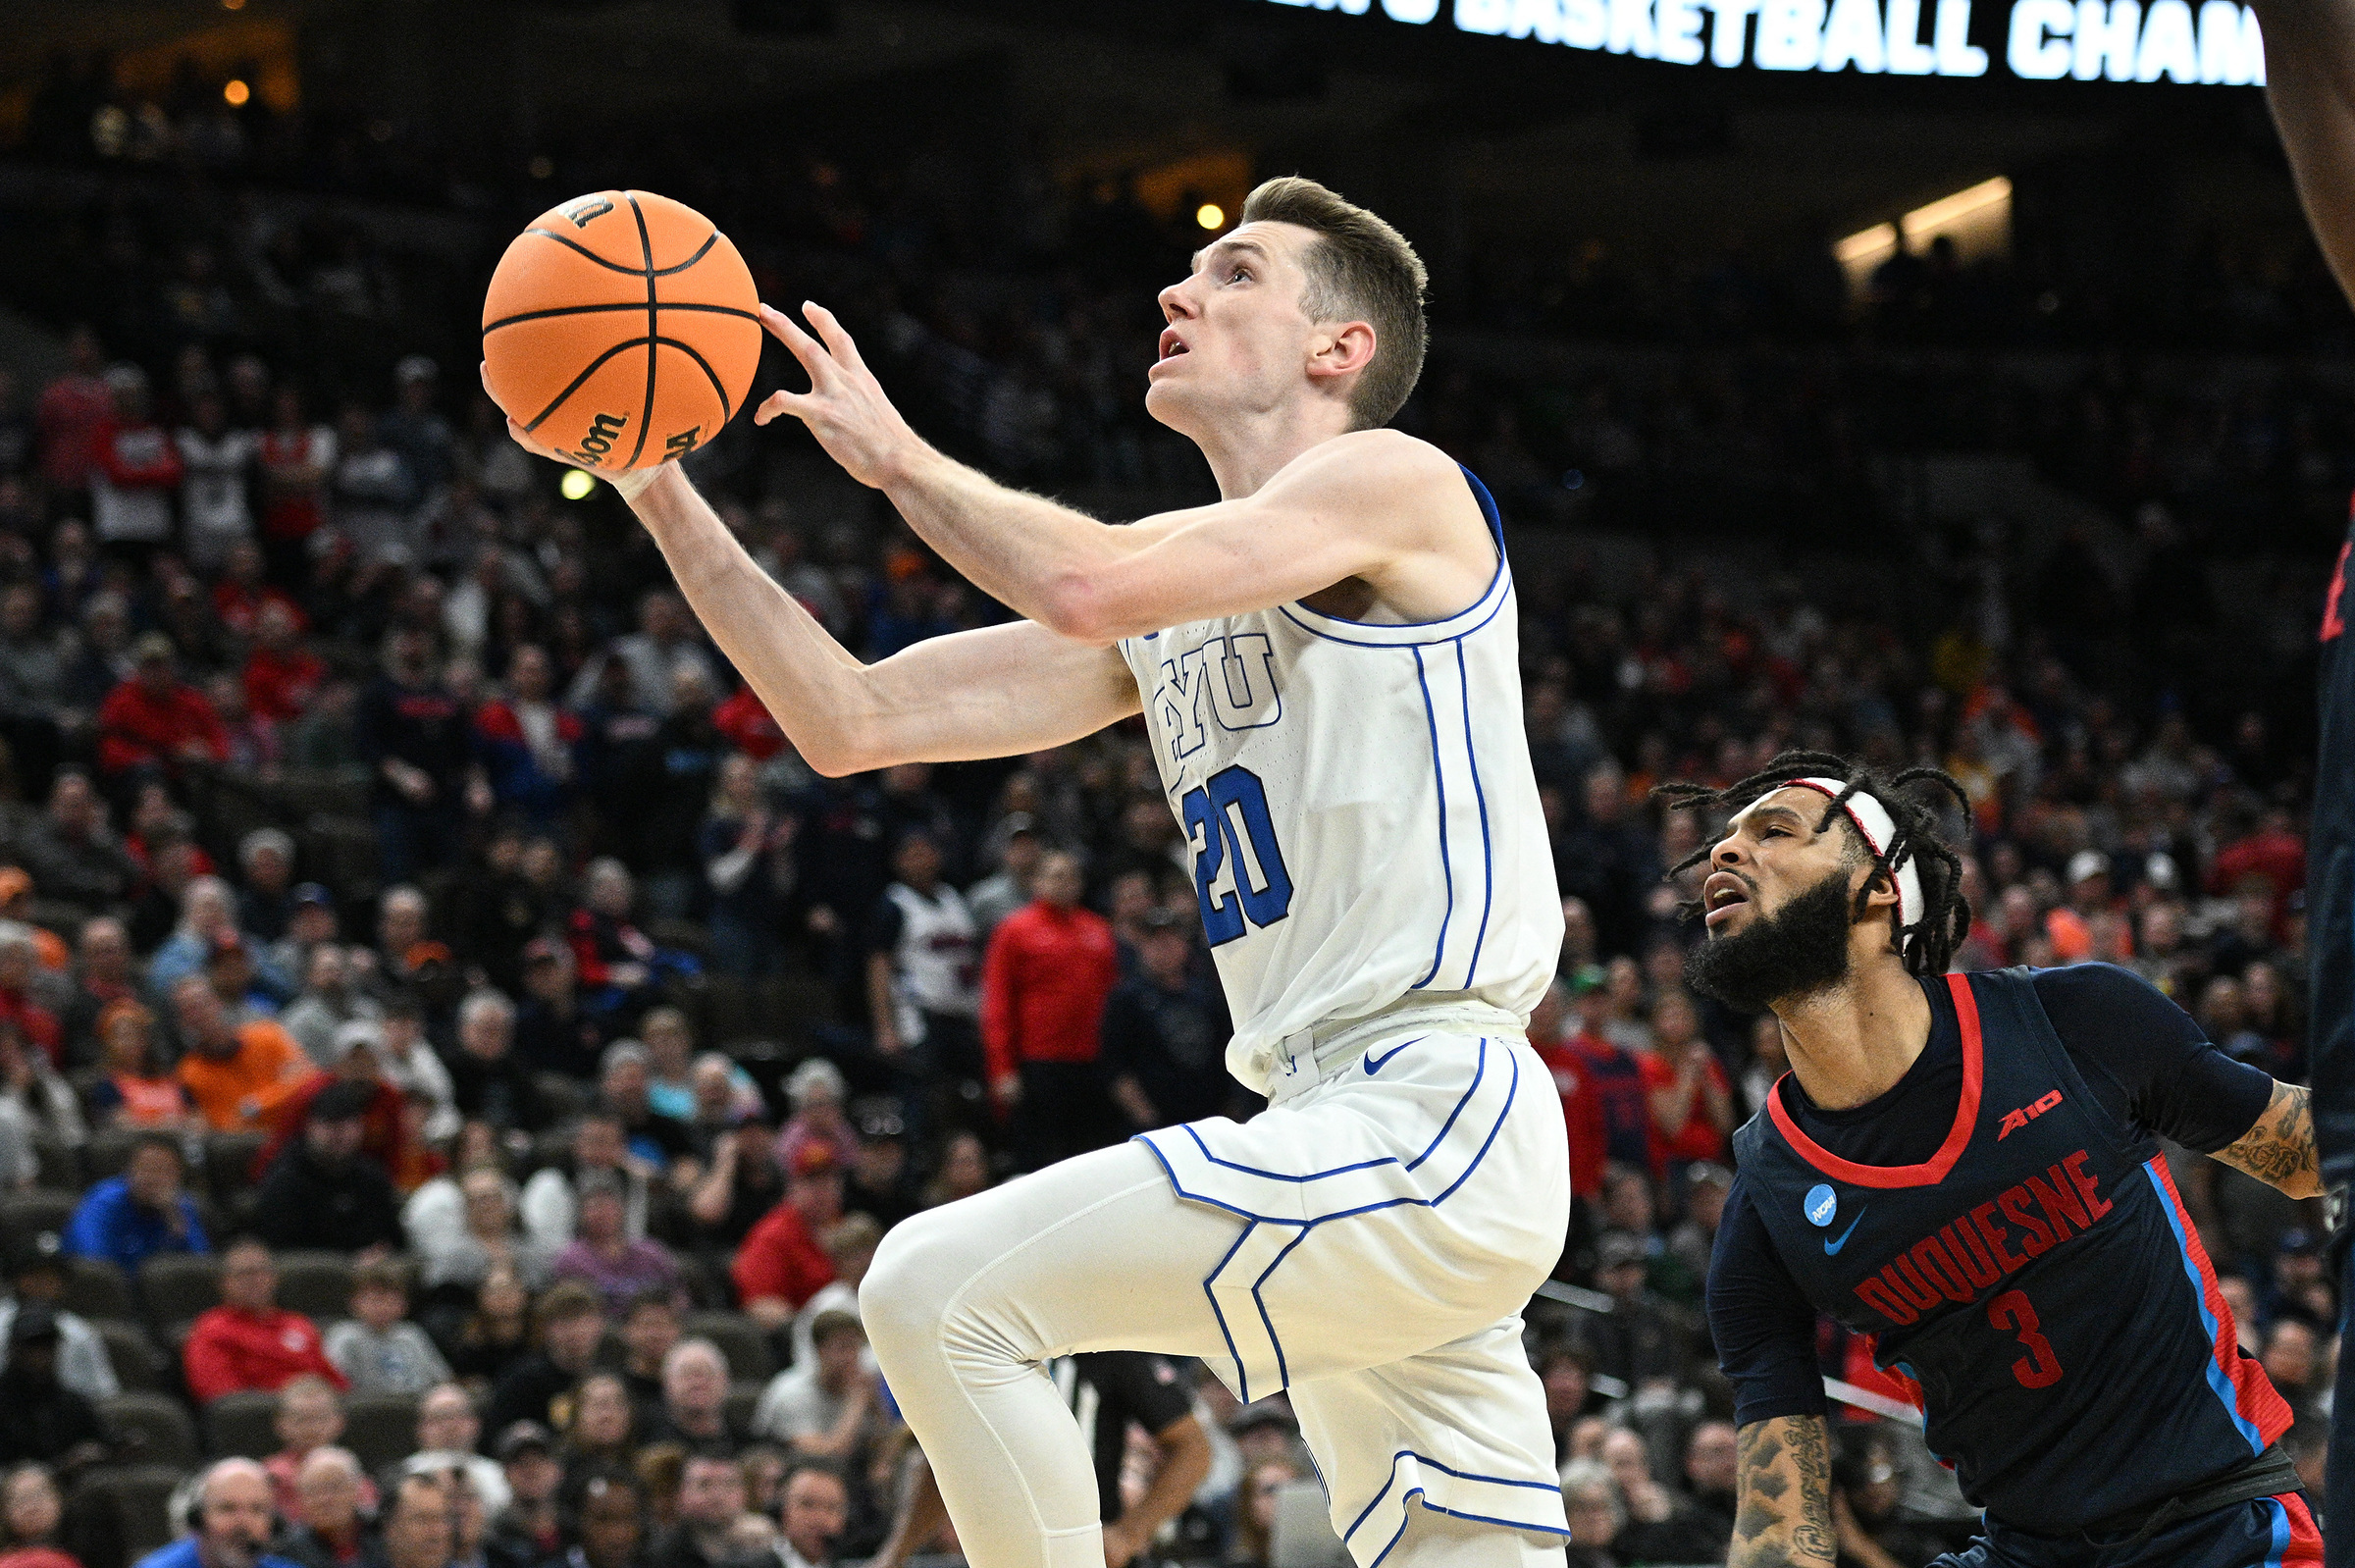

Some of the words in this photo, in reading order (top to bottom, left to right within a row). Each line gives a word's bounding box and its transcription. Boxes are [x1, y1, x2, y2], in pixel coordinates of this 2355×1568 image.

[1180, 763, 1294, 948] 20
[1997, 1089, 2064, 1142] A10
[1852, 1149, 2113, 1326] DUQUESNE
[1987, 1289, 2064, 1389] 3
